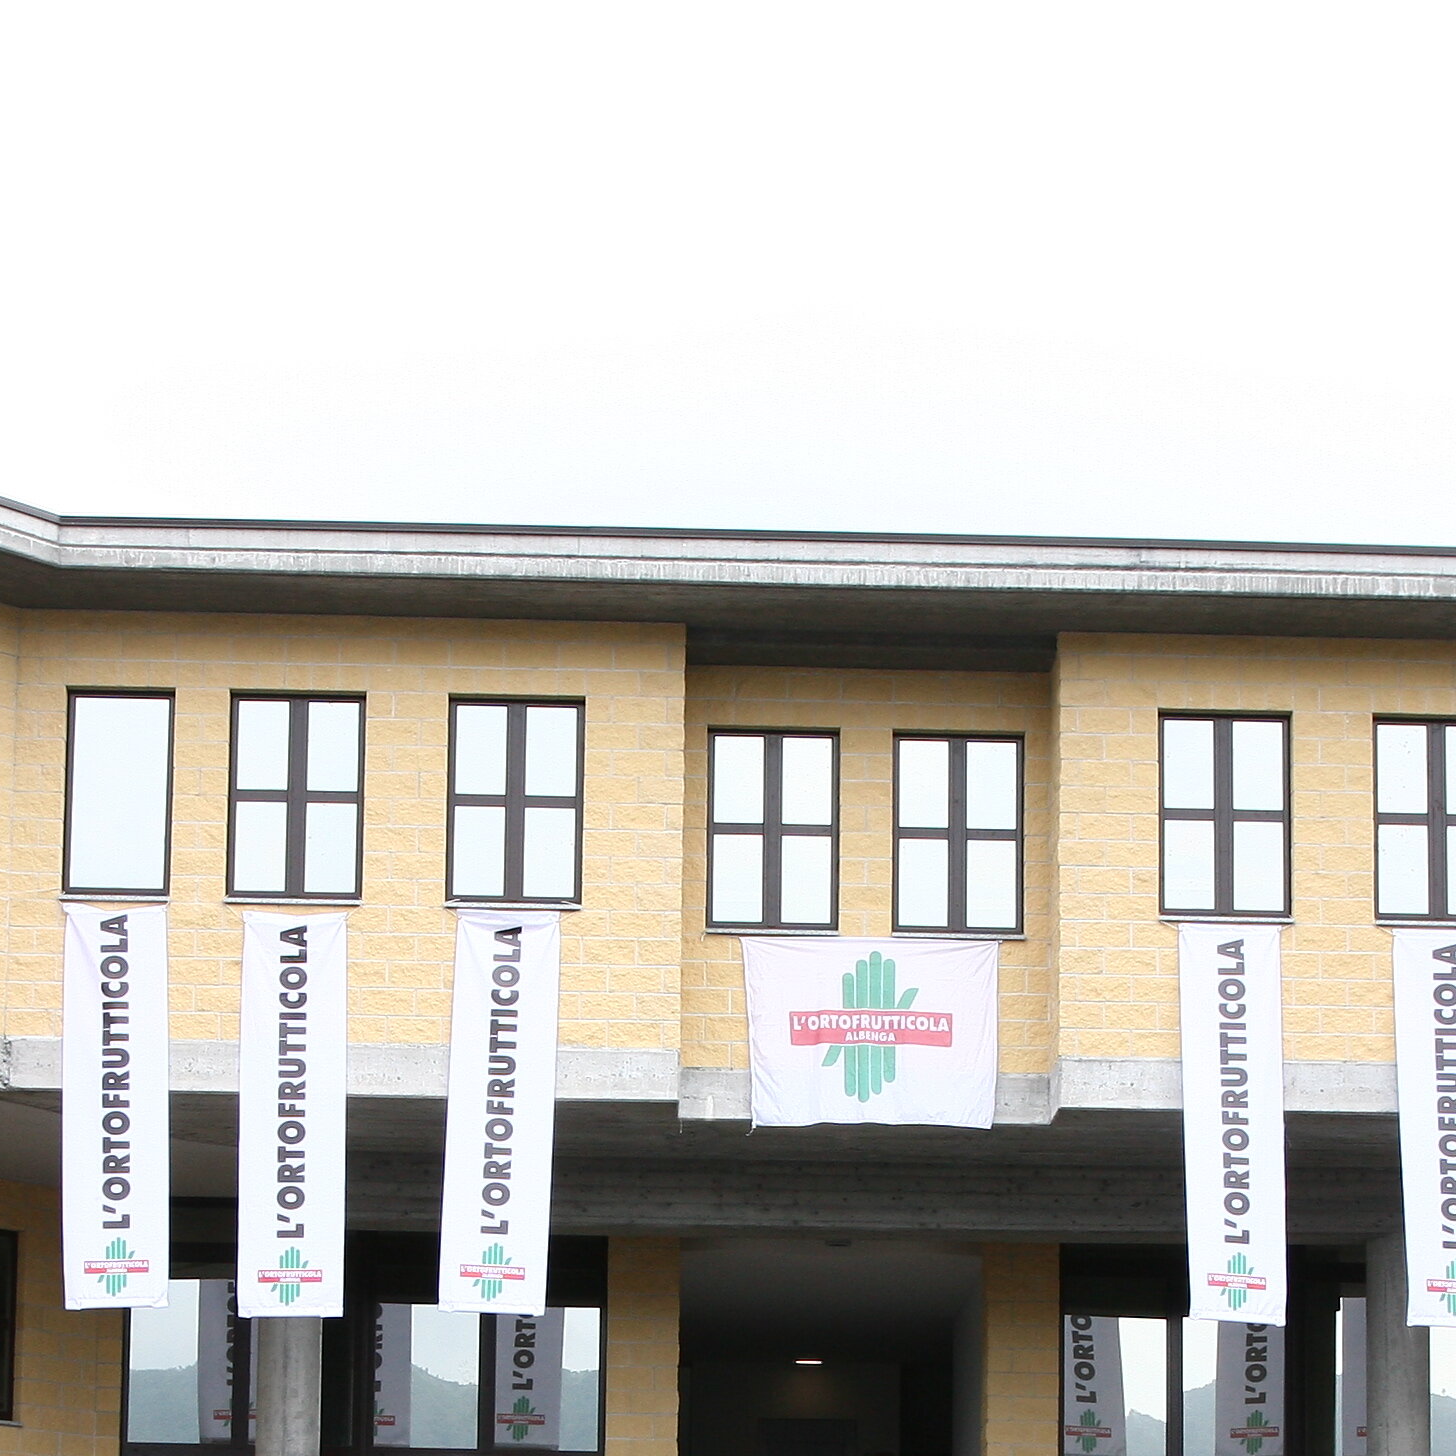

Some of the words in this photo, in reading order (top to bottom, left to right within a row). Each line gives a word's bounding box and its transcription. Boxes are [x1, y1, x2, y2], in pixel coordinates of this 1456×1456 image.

[100, 914, 131, 1230] L'ORTOFRUTTICOLA
[277, 925, 309, 1239] L'ORTOFRUTTICOLA
[480, 925, 523, 1236] L'ORTOFRUTTICOLA
[793, 1013, 950, 1032] L'ORTOFRUTTICOLA
[844, 1031, 896, 1043] ALBENGA
[1217, 938, 1251, 1246] L'ORTOFRUTTICOLA
